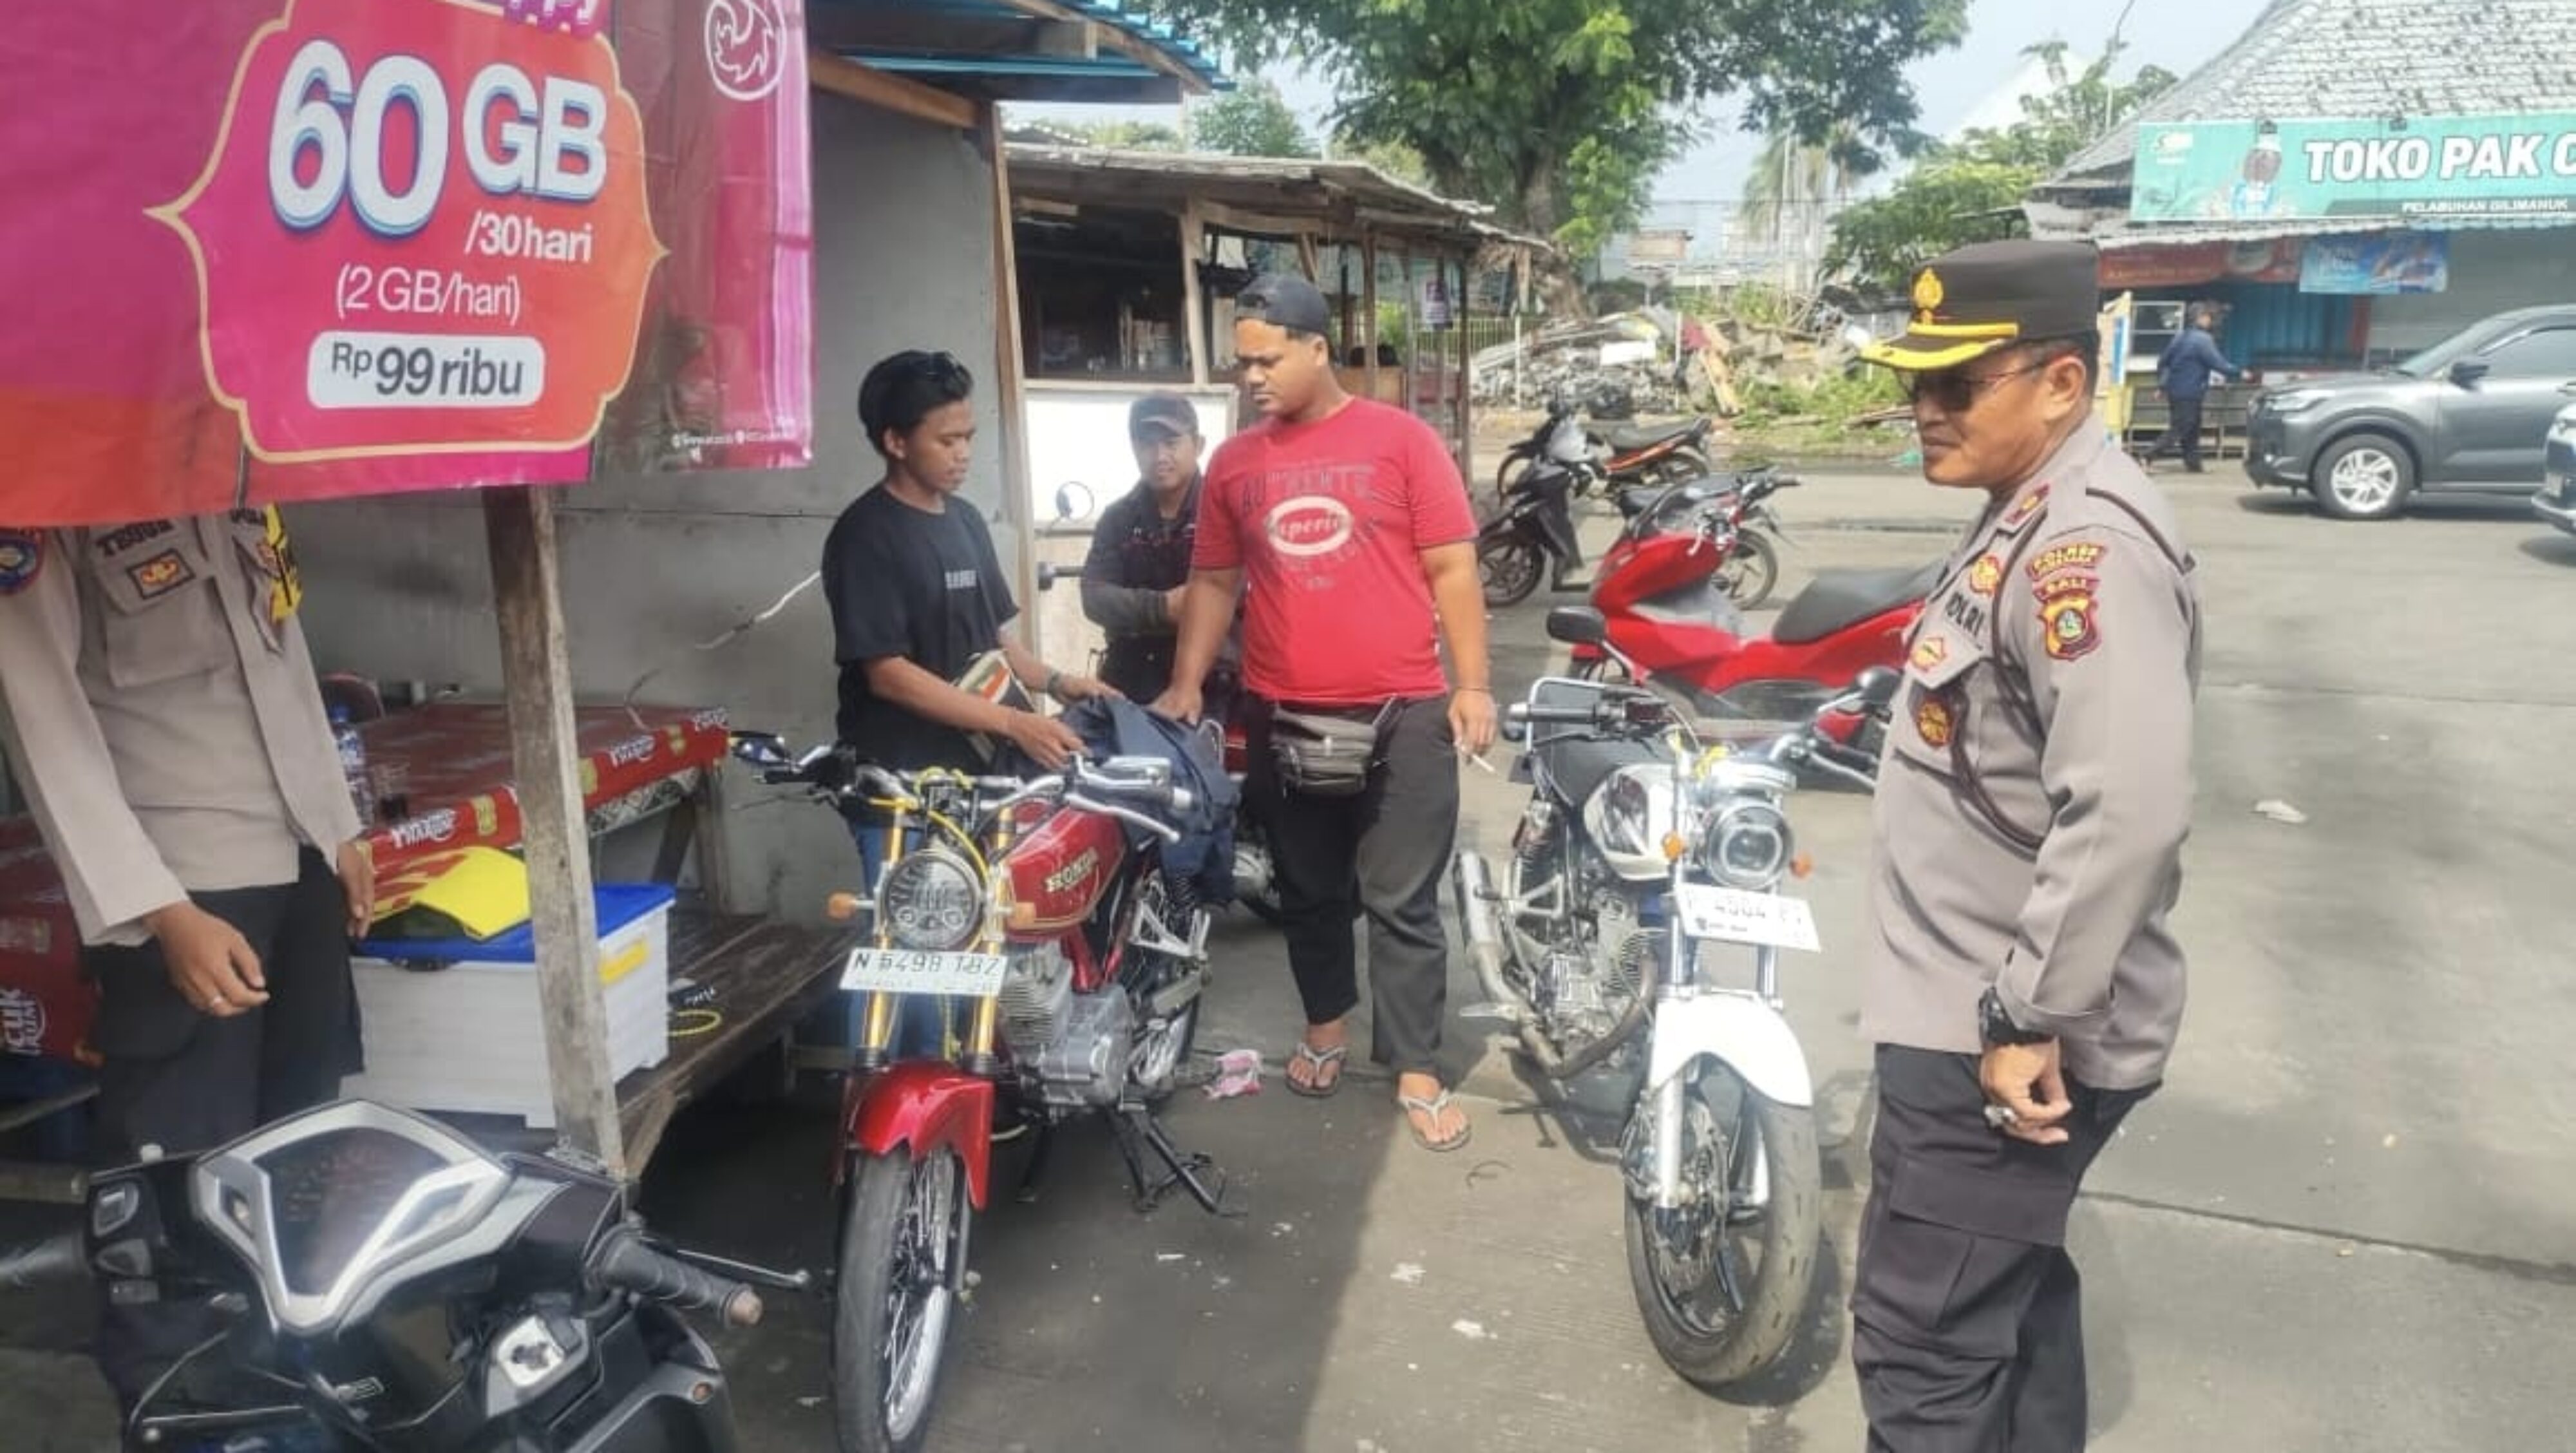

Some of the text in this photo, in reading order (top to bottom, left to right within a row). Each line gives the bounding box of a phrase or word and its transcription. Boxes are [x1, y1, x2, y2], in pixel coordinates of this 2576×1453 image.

[269, 40, 607, 236] 60 GB
[2305, 137, 2431, 182] TOKO
[2439, 133, 2550, 182] PAK
[2401, 200, 2486, 213] PELABUHAN
[332, 343, 523, 395] Rp 99 ribu
[855, 953, 870, 969] N
